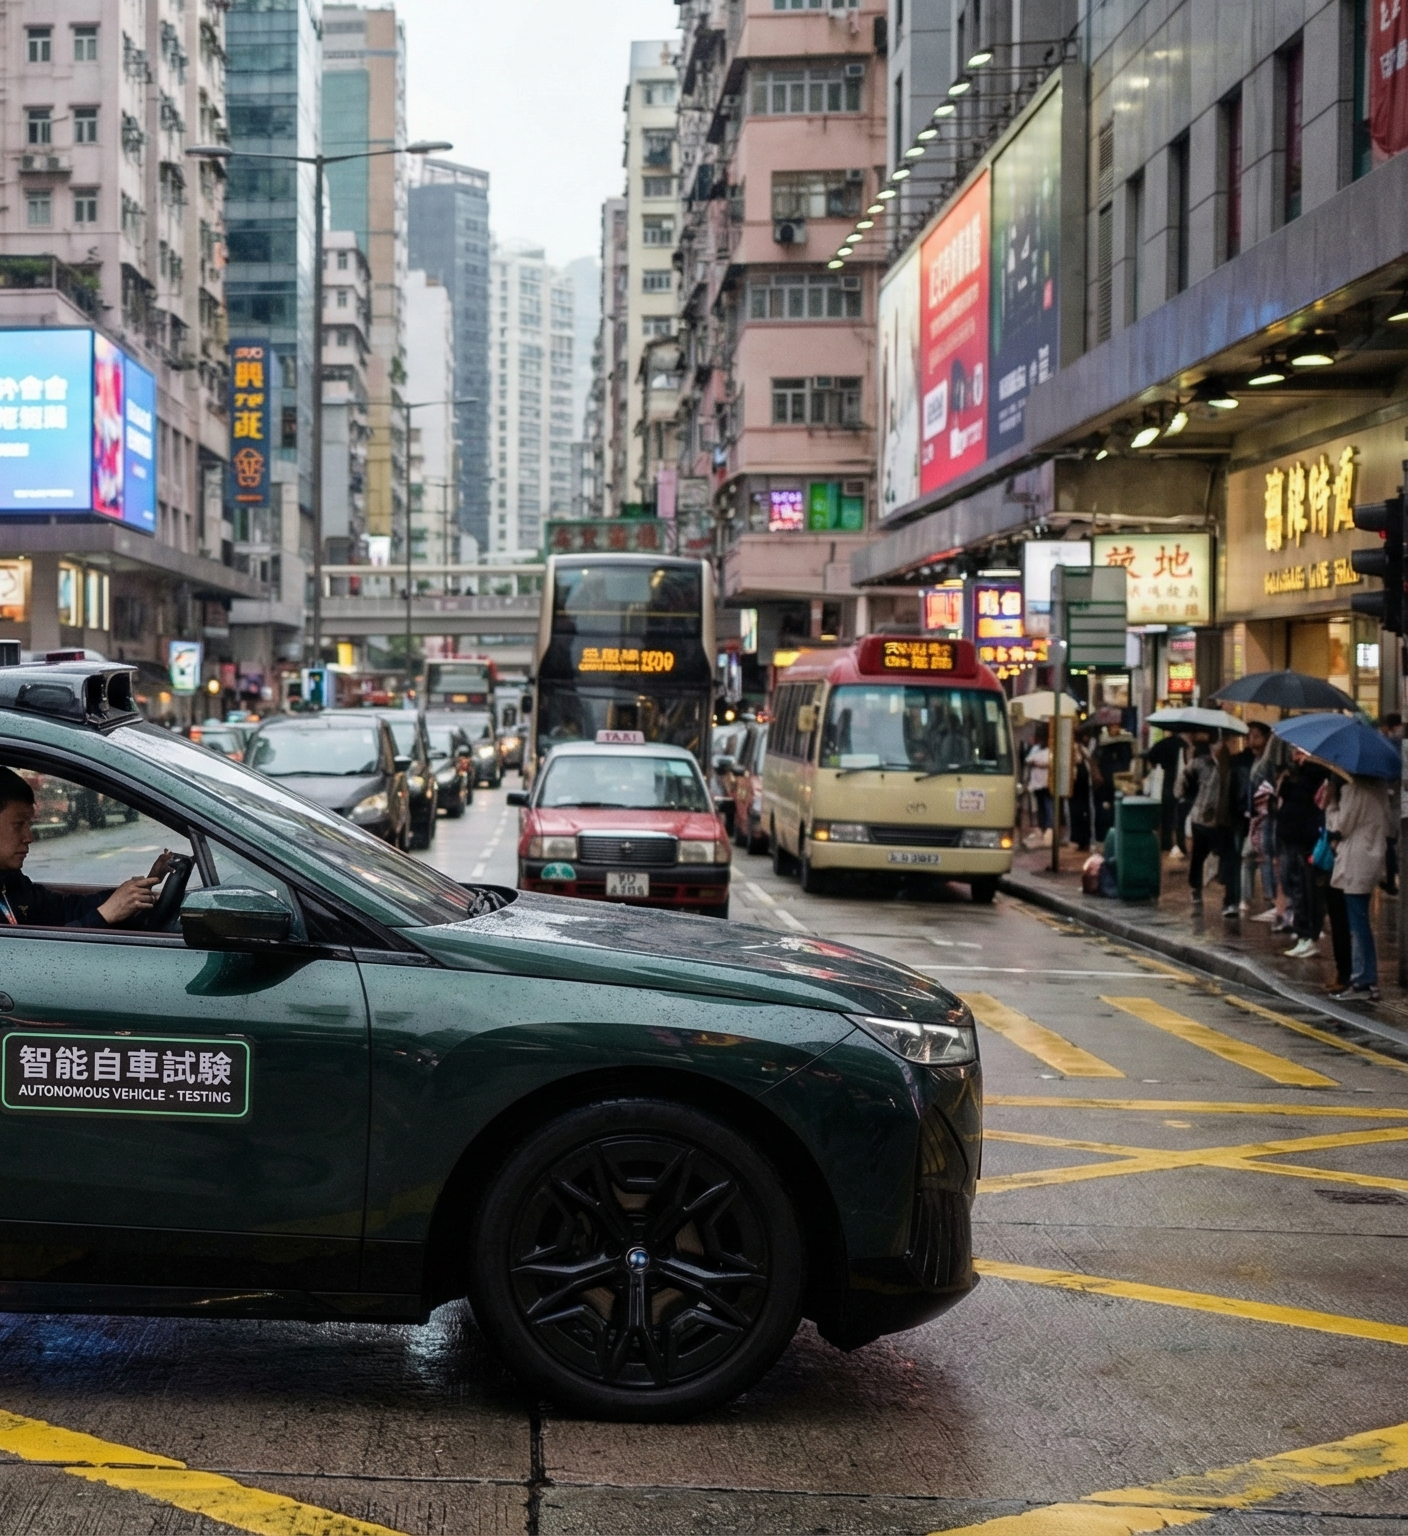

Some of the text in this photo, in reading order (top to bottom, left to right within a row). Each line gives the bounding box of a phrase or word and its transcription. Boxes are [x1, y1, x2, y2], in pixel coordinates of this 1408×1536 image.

[18, 1084, 110, 1099] AUTONOMOUS
[112, 1087, 166, 1101] VEHICLE
[177, 1090, 232, 1104] TESTING
